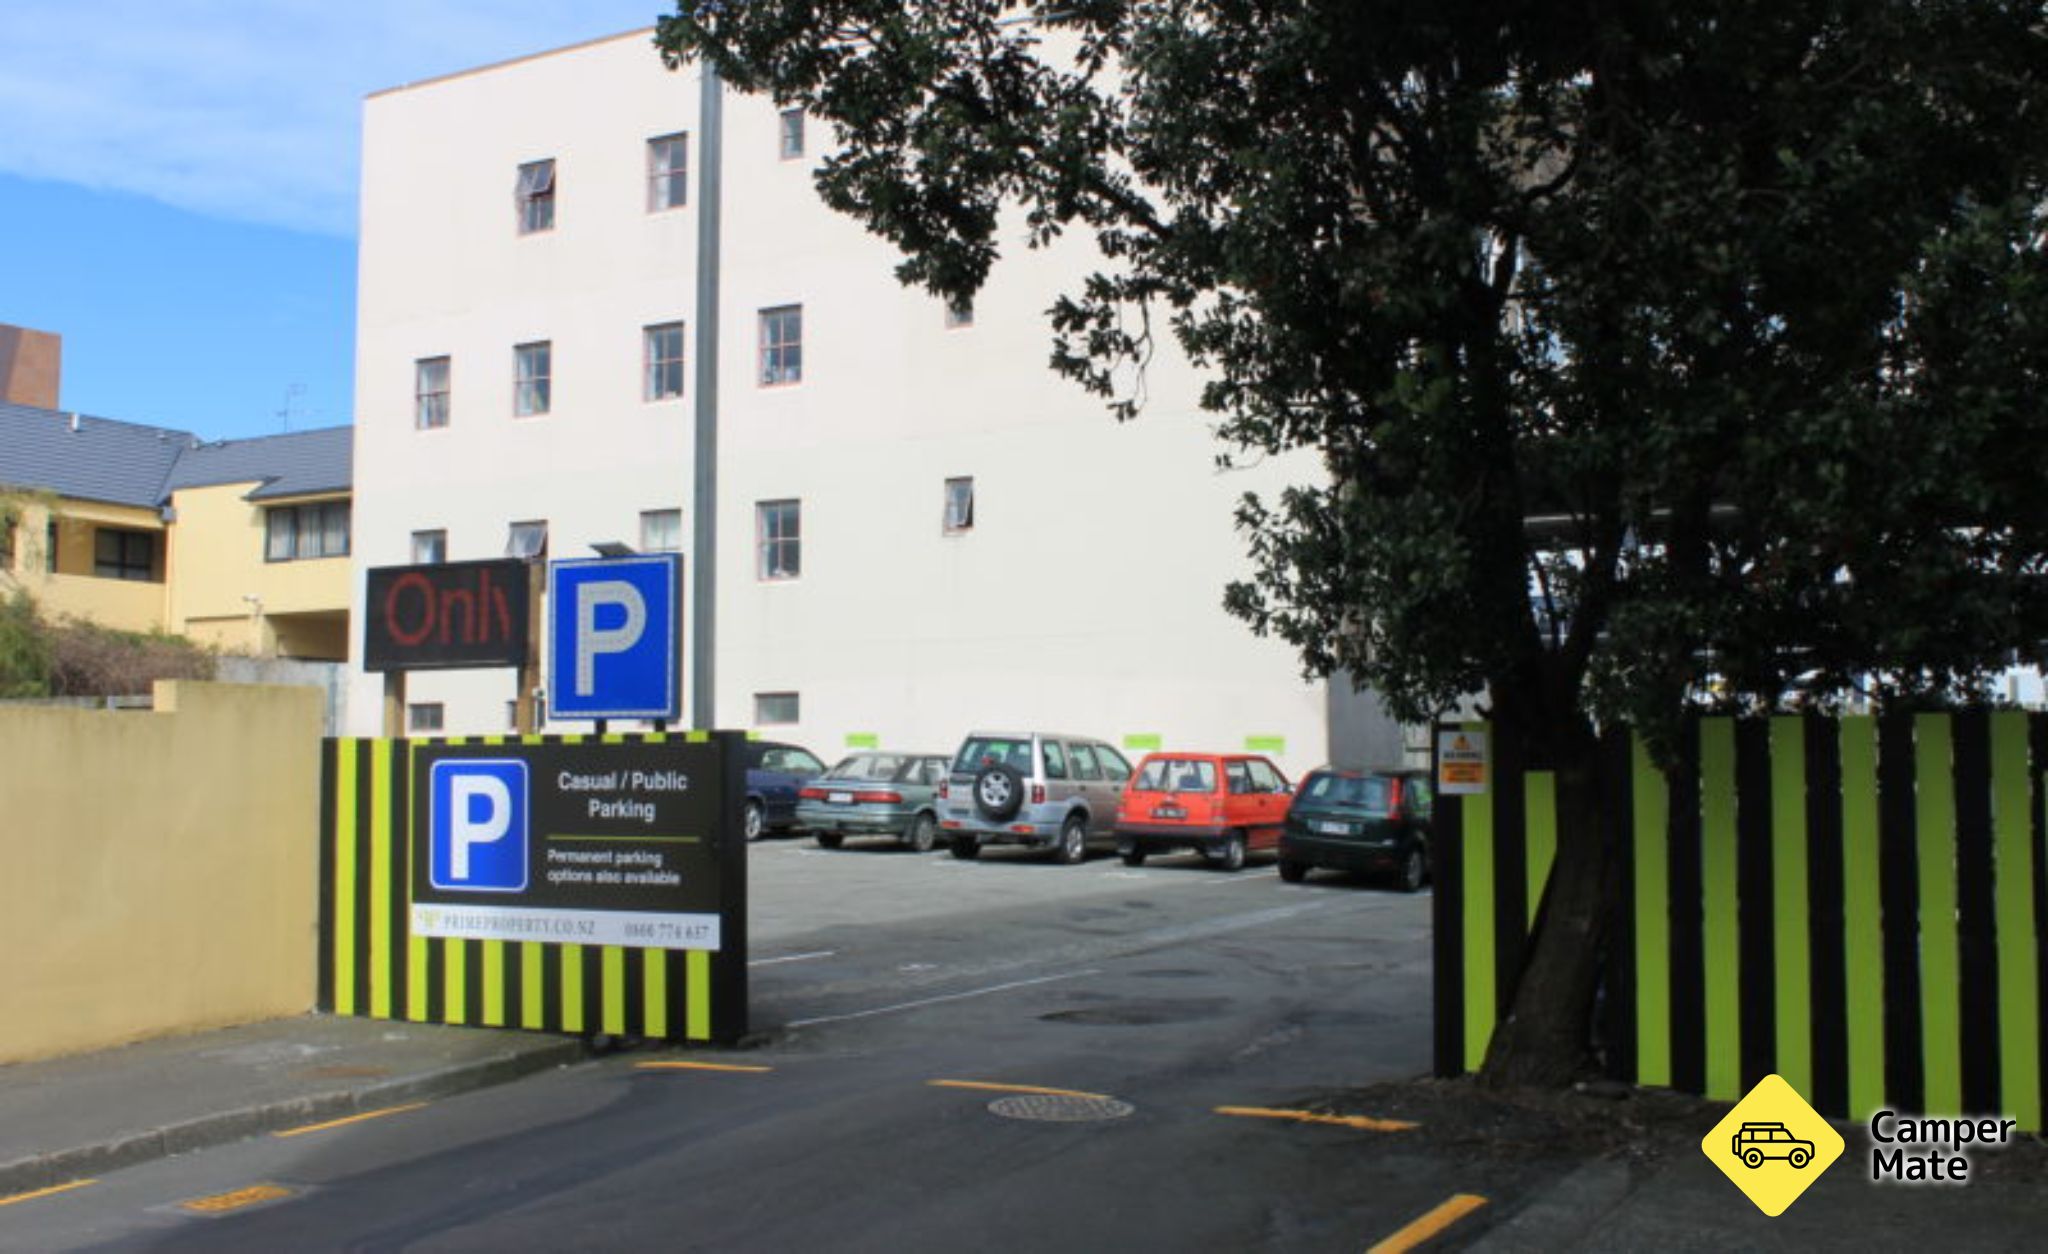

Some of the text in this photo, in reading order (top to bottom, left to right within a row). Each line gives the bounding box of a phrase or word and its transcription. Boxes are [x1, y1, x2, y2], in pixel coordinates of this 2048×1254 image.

[575, 580, 647, 697] P
[558, 771, 688, 790] Casual / Public
[588, 799, 656, 822] Parking
[451, 775, 511, 880] P
[547, 849, 663, 868] Permanent parking
[547, 868, 681, 885] options also available
